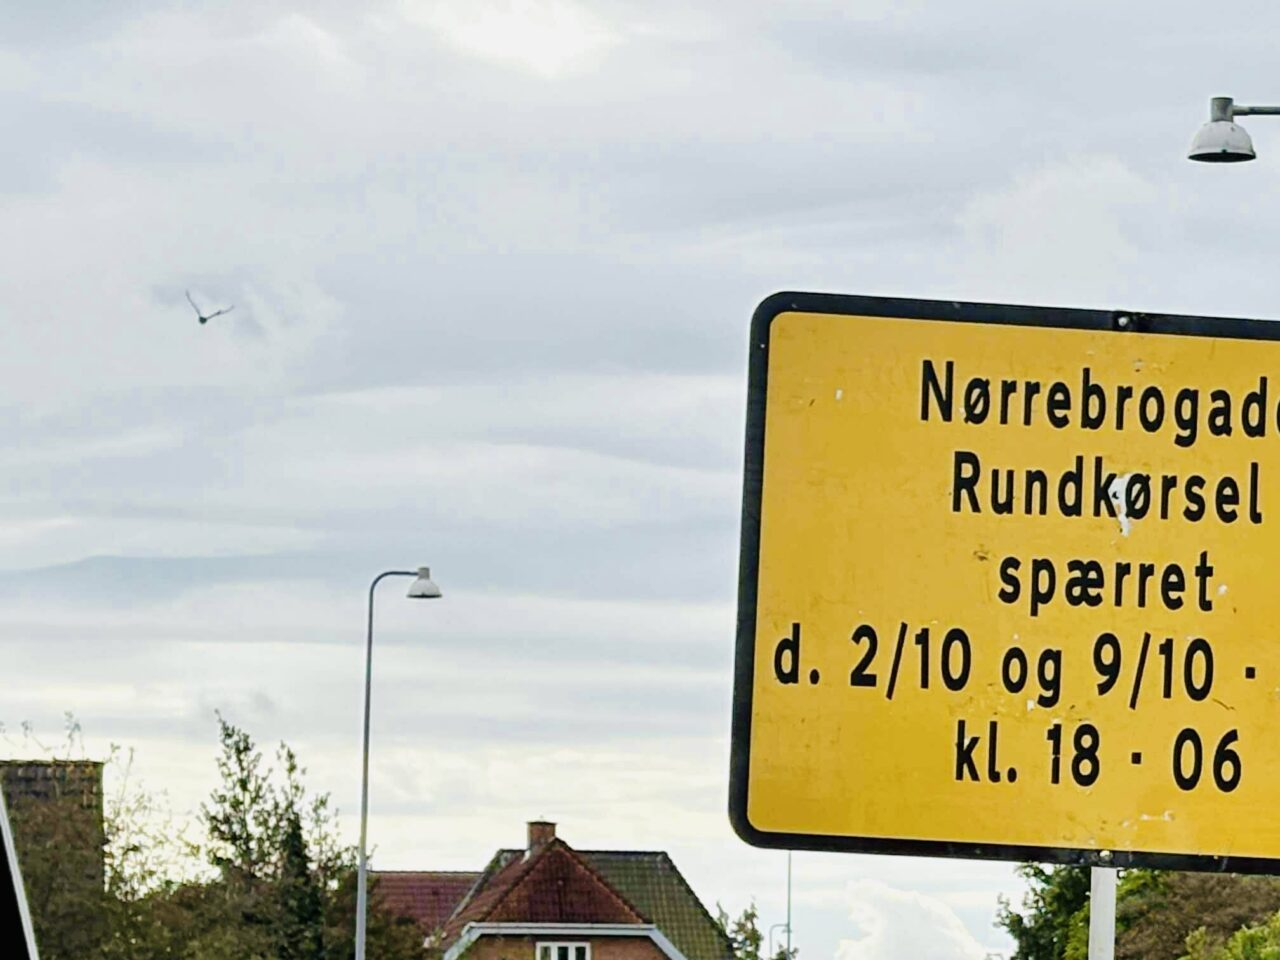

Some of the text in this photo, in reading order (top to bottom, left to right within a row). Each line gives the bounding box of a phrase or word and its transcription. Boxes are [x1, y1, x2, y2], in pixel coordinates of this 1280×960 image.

[952, 450, 1262, 525] Rundkørsel
[998, 550, 1214, 617] spærret
[774, 622, 820, 685] d.
[850, 622, 972, 700] 2/10
[1002, 646, 1062, 709] og
[1093, 632, 1214, 710] 9/10
[955, 719, 1017, 783] kl.
[1046, 723, 1100, 787] 18
[1172, 727, 1242, 793] 06
